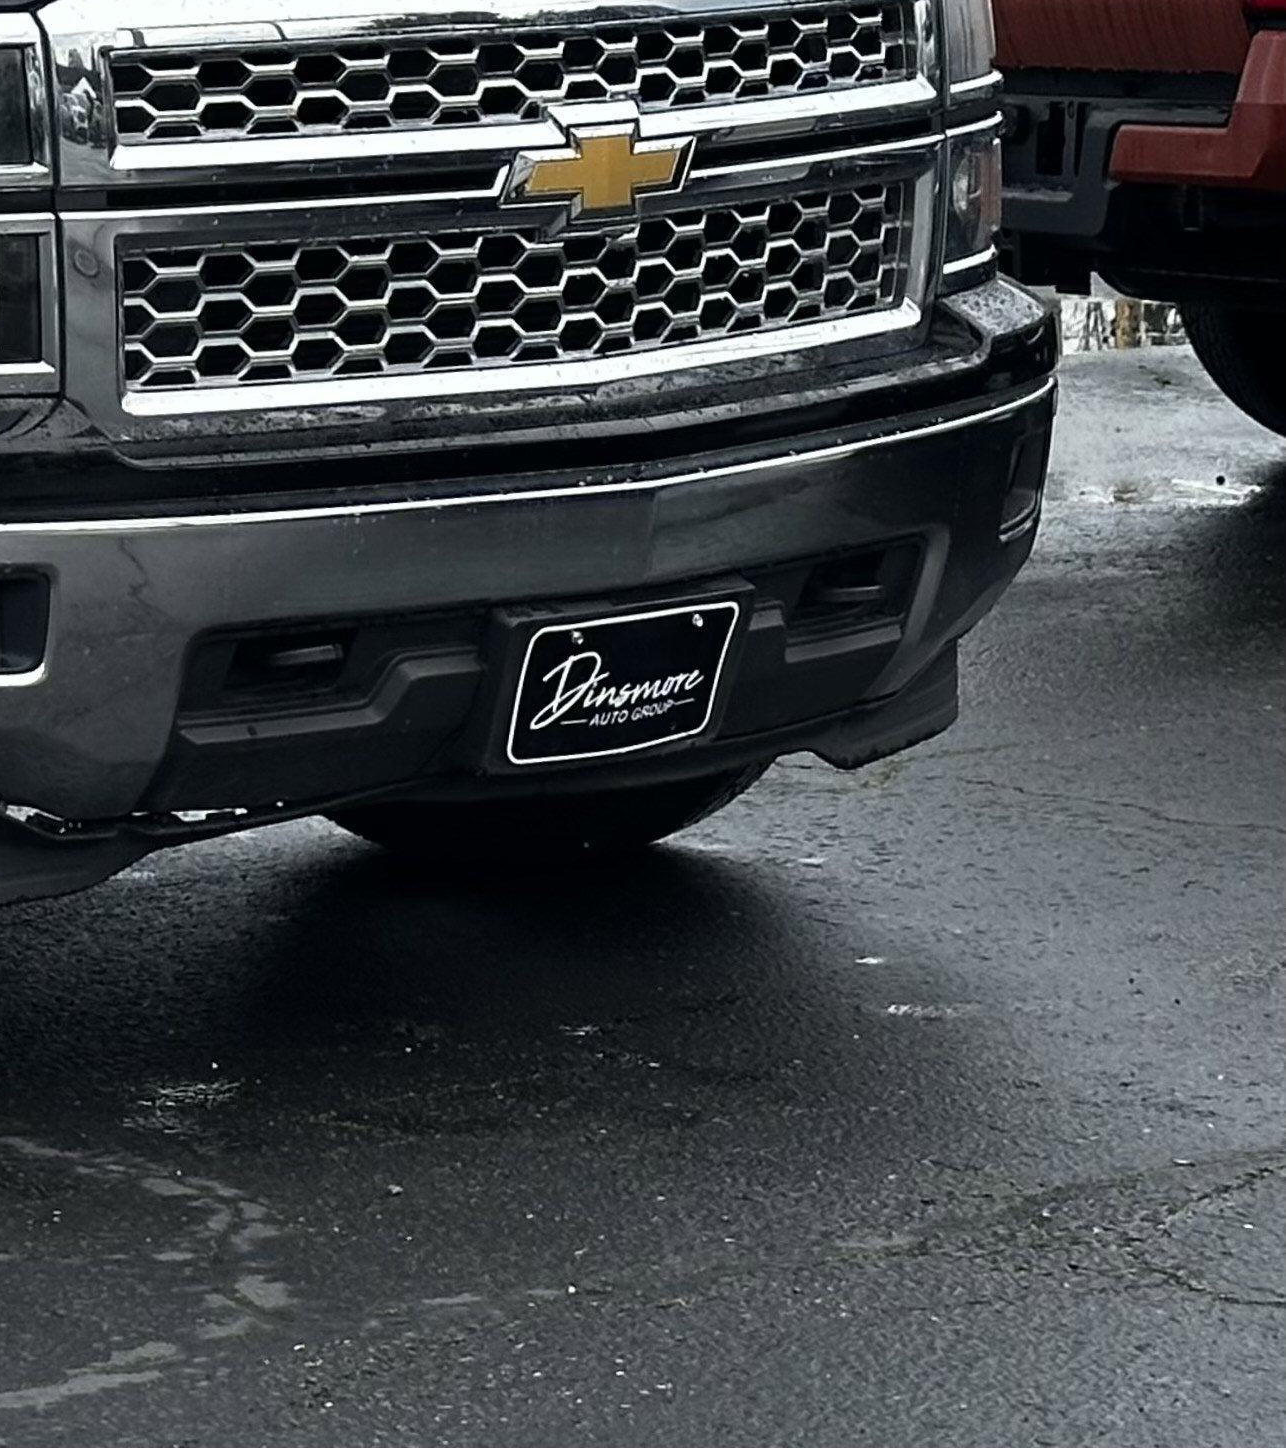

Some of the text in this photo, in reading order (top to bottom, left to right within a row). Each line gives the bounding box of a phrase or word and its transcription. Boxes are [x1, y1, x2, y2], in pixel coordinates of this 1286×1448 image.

[529, 651, 705, 730] Dinsmore
[589, 699, 676, 727] AUTO GROUP
